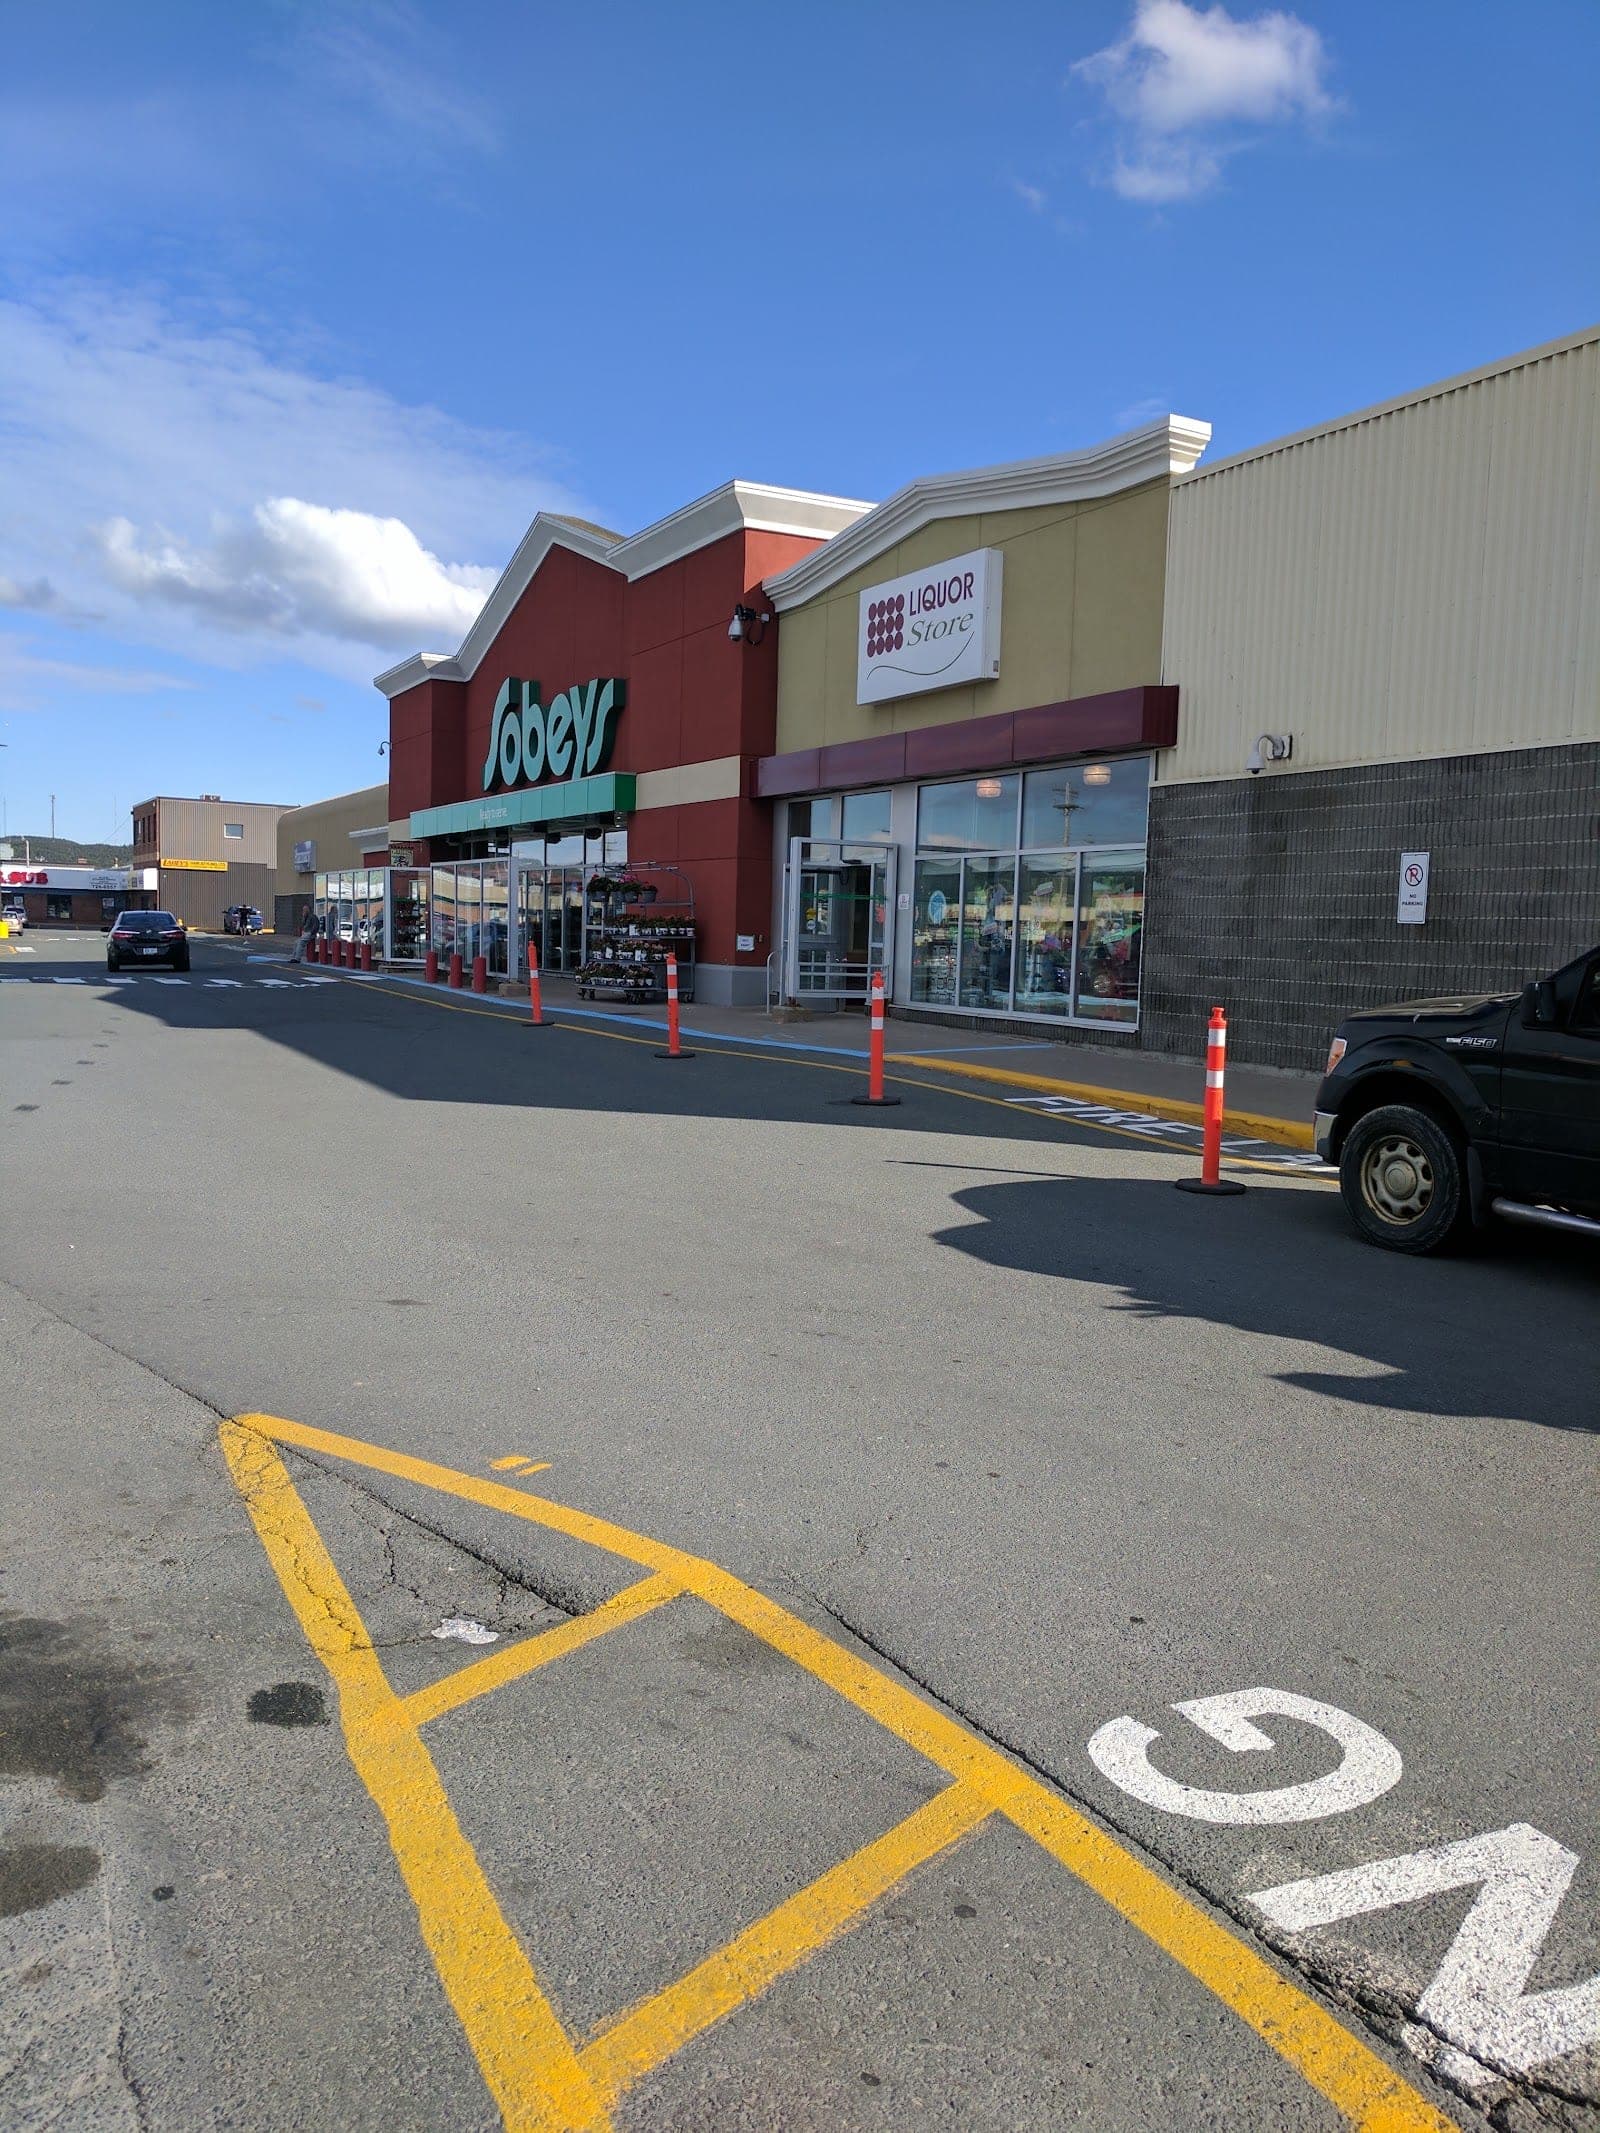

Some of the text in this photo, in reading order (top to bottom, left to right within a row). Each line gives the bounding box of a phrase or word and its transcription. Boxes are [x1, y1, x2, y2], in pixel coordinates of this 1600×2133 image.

[909, 572, 974, 616] LIQUOR
[907, 613, 974, 646] Store
[484, 677, 619, 792] Sobeys
[1003, 1095, 1205, 1136] FIRE
